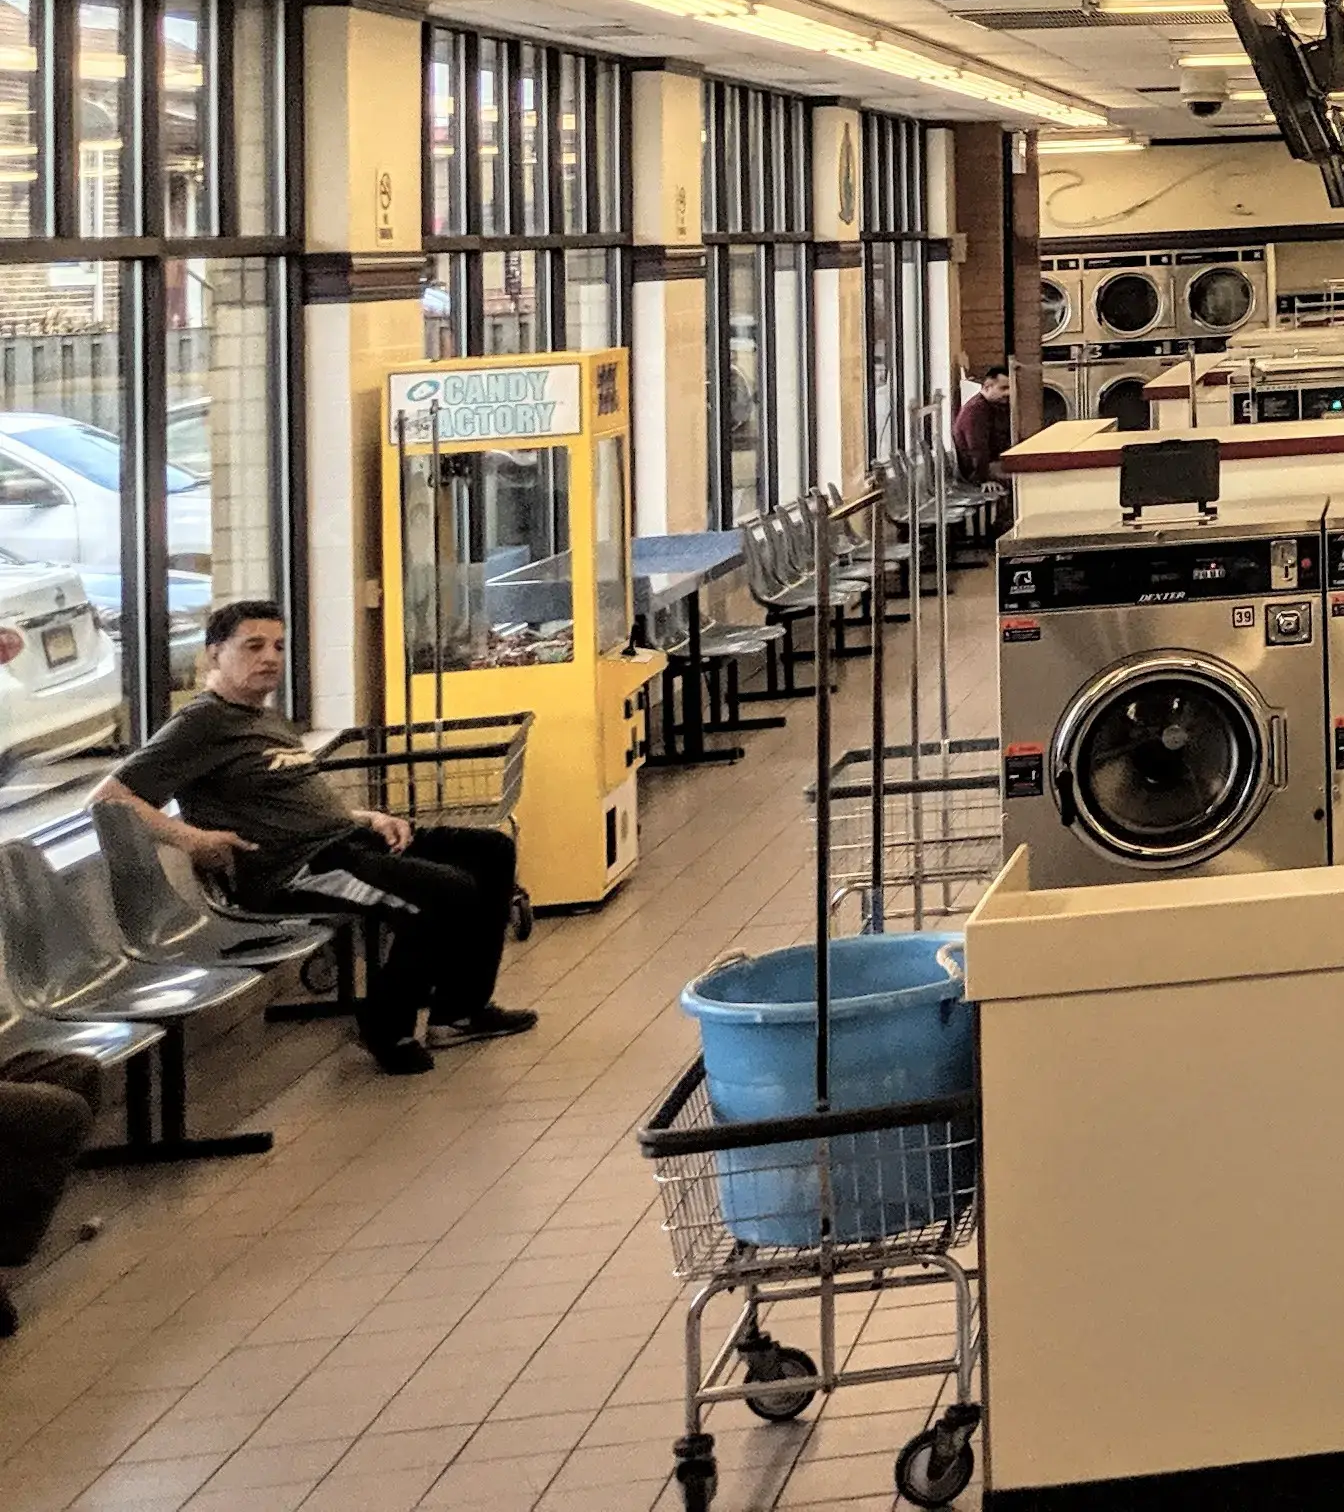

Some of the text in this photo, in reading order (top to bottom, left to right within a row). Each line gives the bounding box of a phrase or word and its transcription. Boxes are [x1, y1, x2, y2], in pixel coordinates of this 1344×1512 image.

[443, 371, 549, 406] CANDY
[1138, 591, 1186, 603] DEXTER
[1236, 609, 1251, 624] 39
